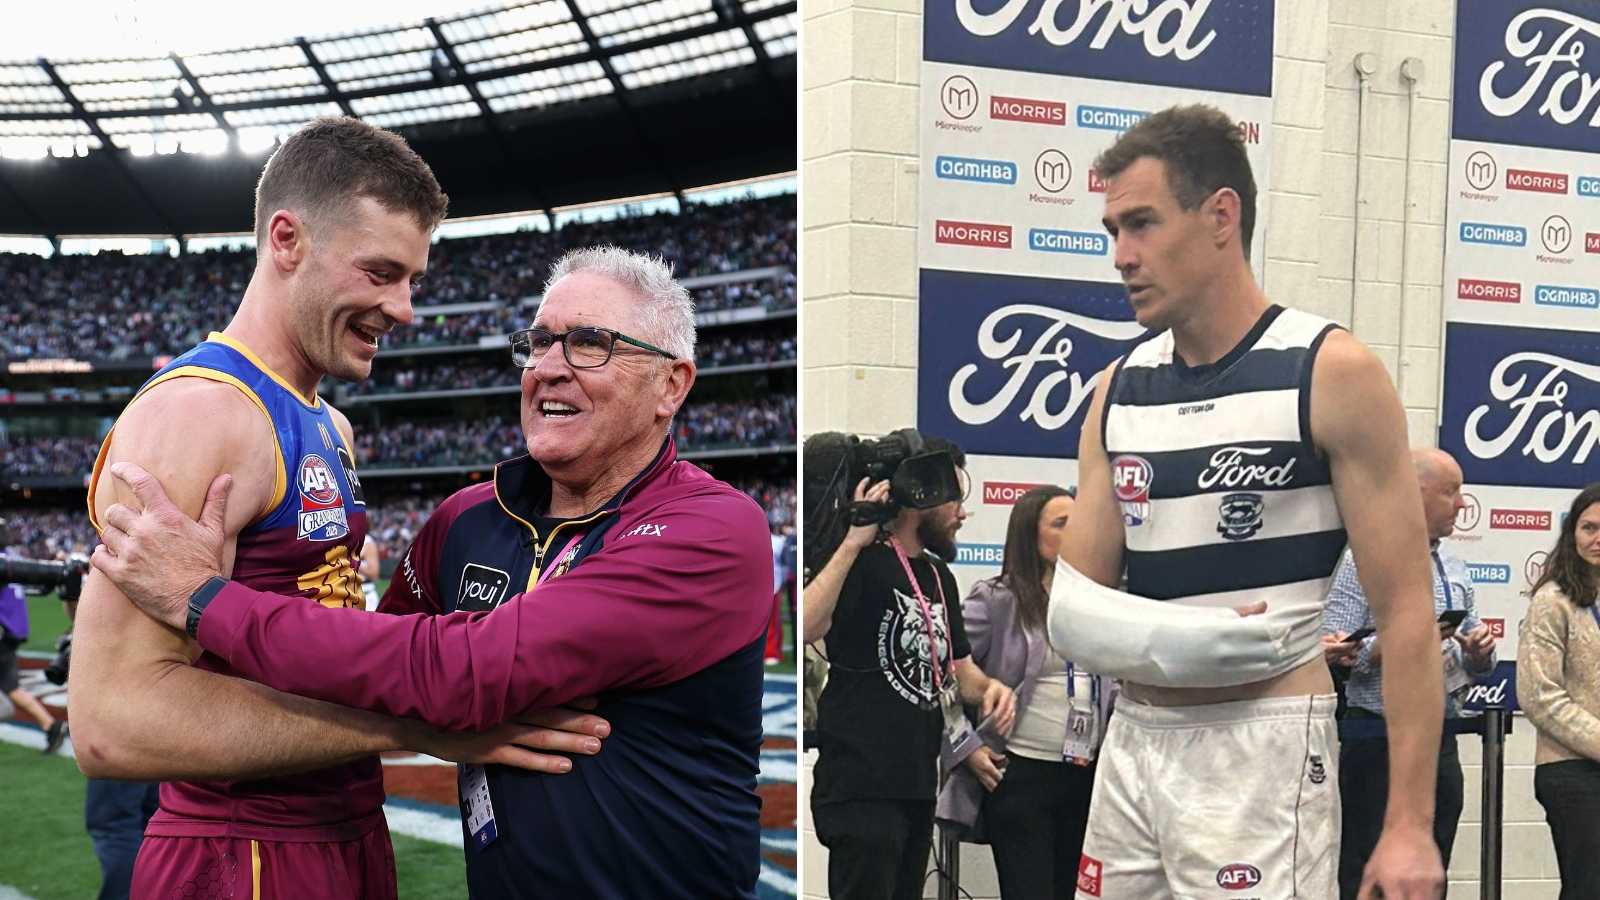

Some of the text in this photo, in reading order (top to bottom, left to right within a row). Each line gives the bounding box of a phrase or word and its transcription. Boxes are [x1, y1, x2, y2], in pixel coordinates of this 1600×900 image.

[993, 101, 1064, 120] MORRIS
[1094, 110, 1146, 128] GMHB
[1507, 174, 1567, 190] MORRIS
[938, 226, 1009, 243] MORRIS
[1460, 284, 1519, 299] MORRIS
[1464, 352, 1600, 464] For
[1113, 466, 1147, 487] AFL
[1198, 447, 1296, 490] Ford
[304, 466, 337, 493] AFL
[985, 486, 1027, 500] MOR
[1492, 513, 1549, 527] MORRIS
[957, 546, 1004, 562] MHBA
[1466, 567, 1507, 581] MHBA
[460, 579, 502, 604] youi
[878, 608, 920, 705] RENEGADES
[1465, 678, 1508, 704] rd
[1220, 869, 1258, 884] AFL
